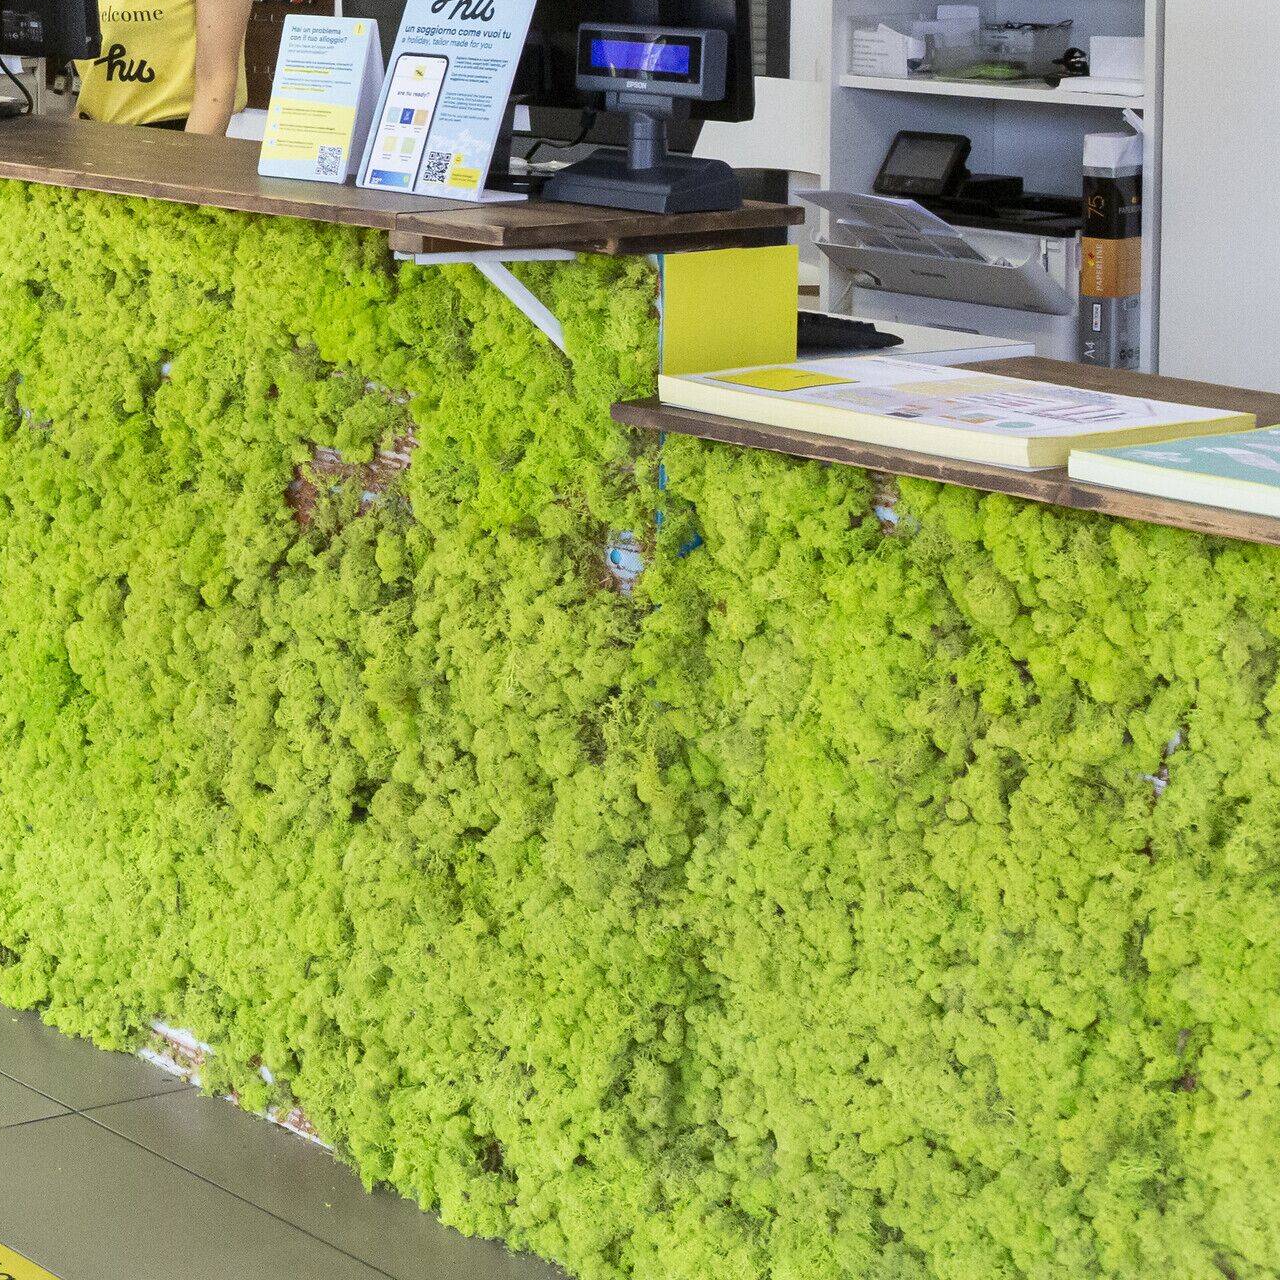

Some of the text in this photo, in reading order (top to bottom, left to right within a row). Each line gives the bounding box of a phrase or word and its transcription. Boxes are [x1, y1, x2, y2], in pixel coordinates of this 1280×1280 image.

[100, 5, 164, 22] elcome
[404, 25, 512, 39] un soggiorno come vuoi tu
[450, 39, 469, 48] made
[94, 43, 156, 83] hu
[626, 80, 647, 90] EPSON
[1088, 195, 1105, 219] 75
[1094, 242, 1104, 292] PAPERLINE
[1084, 340, 1096, 360] A4
